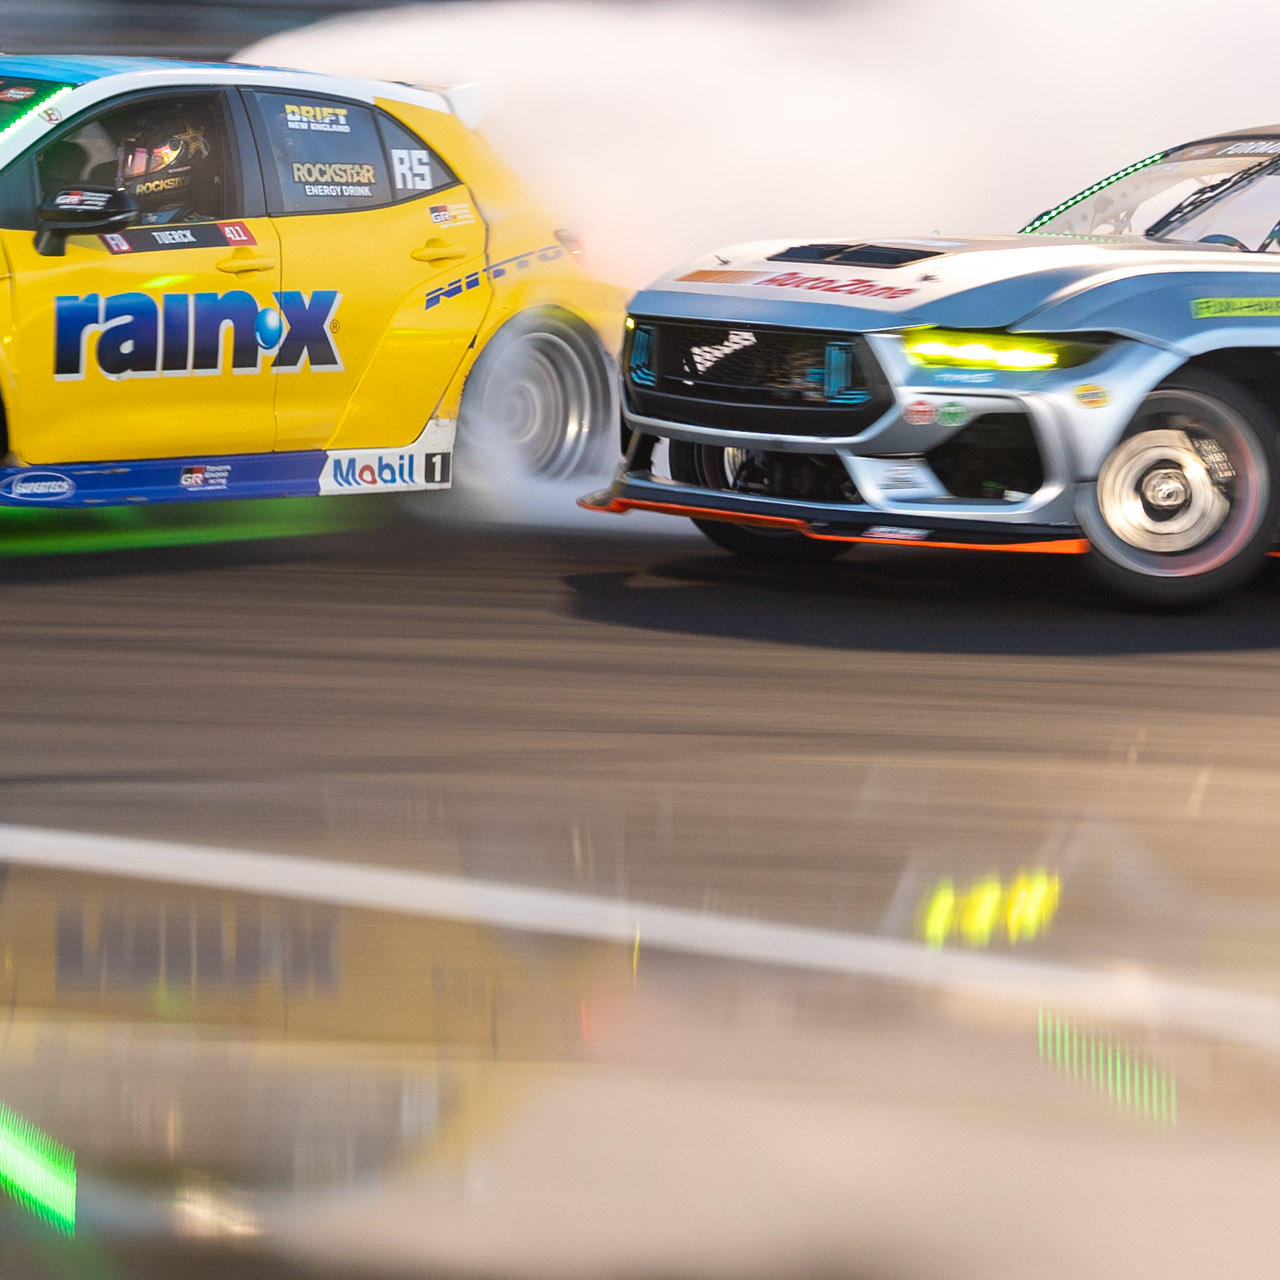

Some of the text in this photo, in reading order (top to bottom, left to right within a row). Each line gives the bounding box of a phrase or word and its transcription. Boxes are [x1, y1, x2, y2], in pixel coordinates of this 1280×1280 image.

[285, 104, 348, 124] DRIFT
[287, 121, 351, 133] NEW ENGLAND
[293, 162, 376, 184] ROCKSTAR
[391, 149, 432, 189] RS
[305, 185, 372, 197] ENERGY DRINK
[151, 229, 197, 245] TUERCK
[223, 226, 248, 241] 411
[753, 271, 921, 300] AutoZone
[180, 473, 204, 486] GR
[333, 454, 416, 487] Mobil
